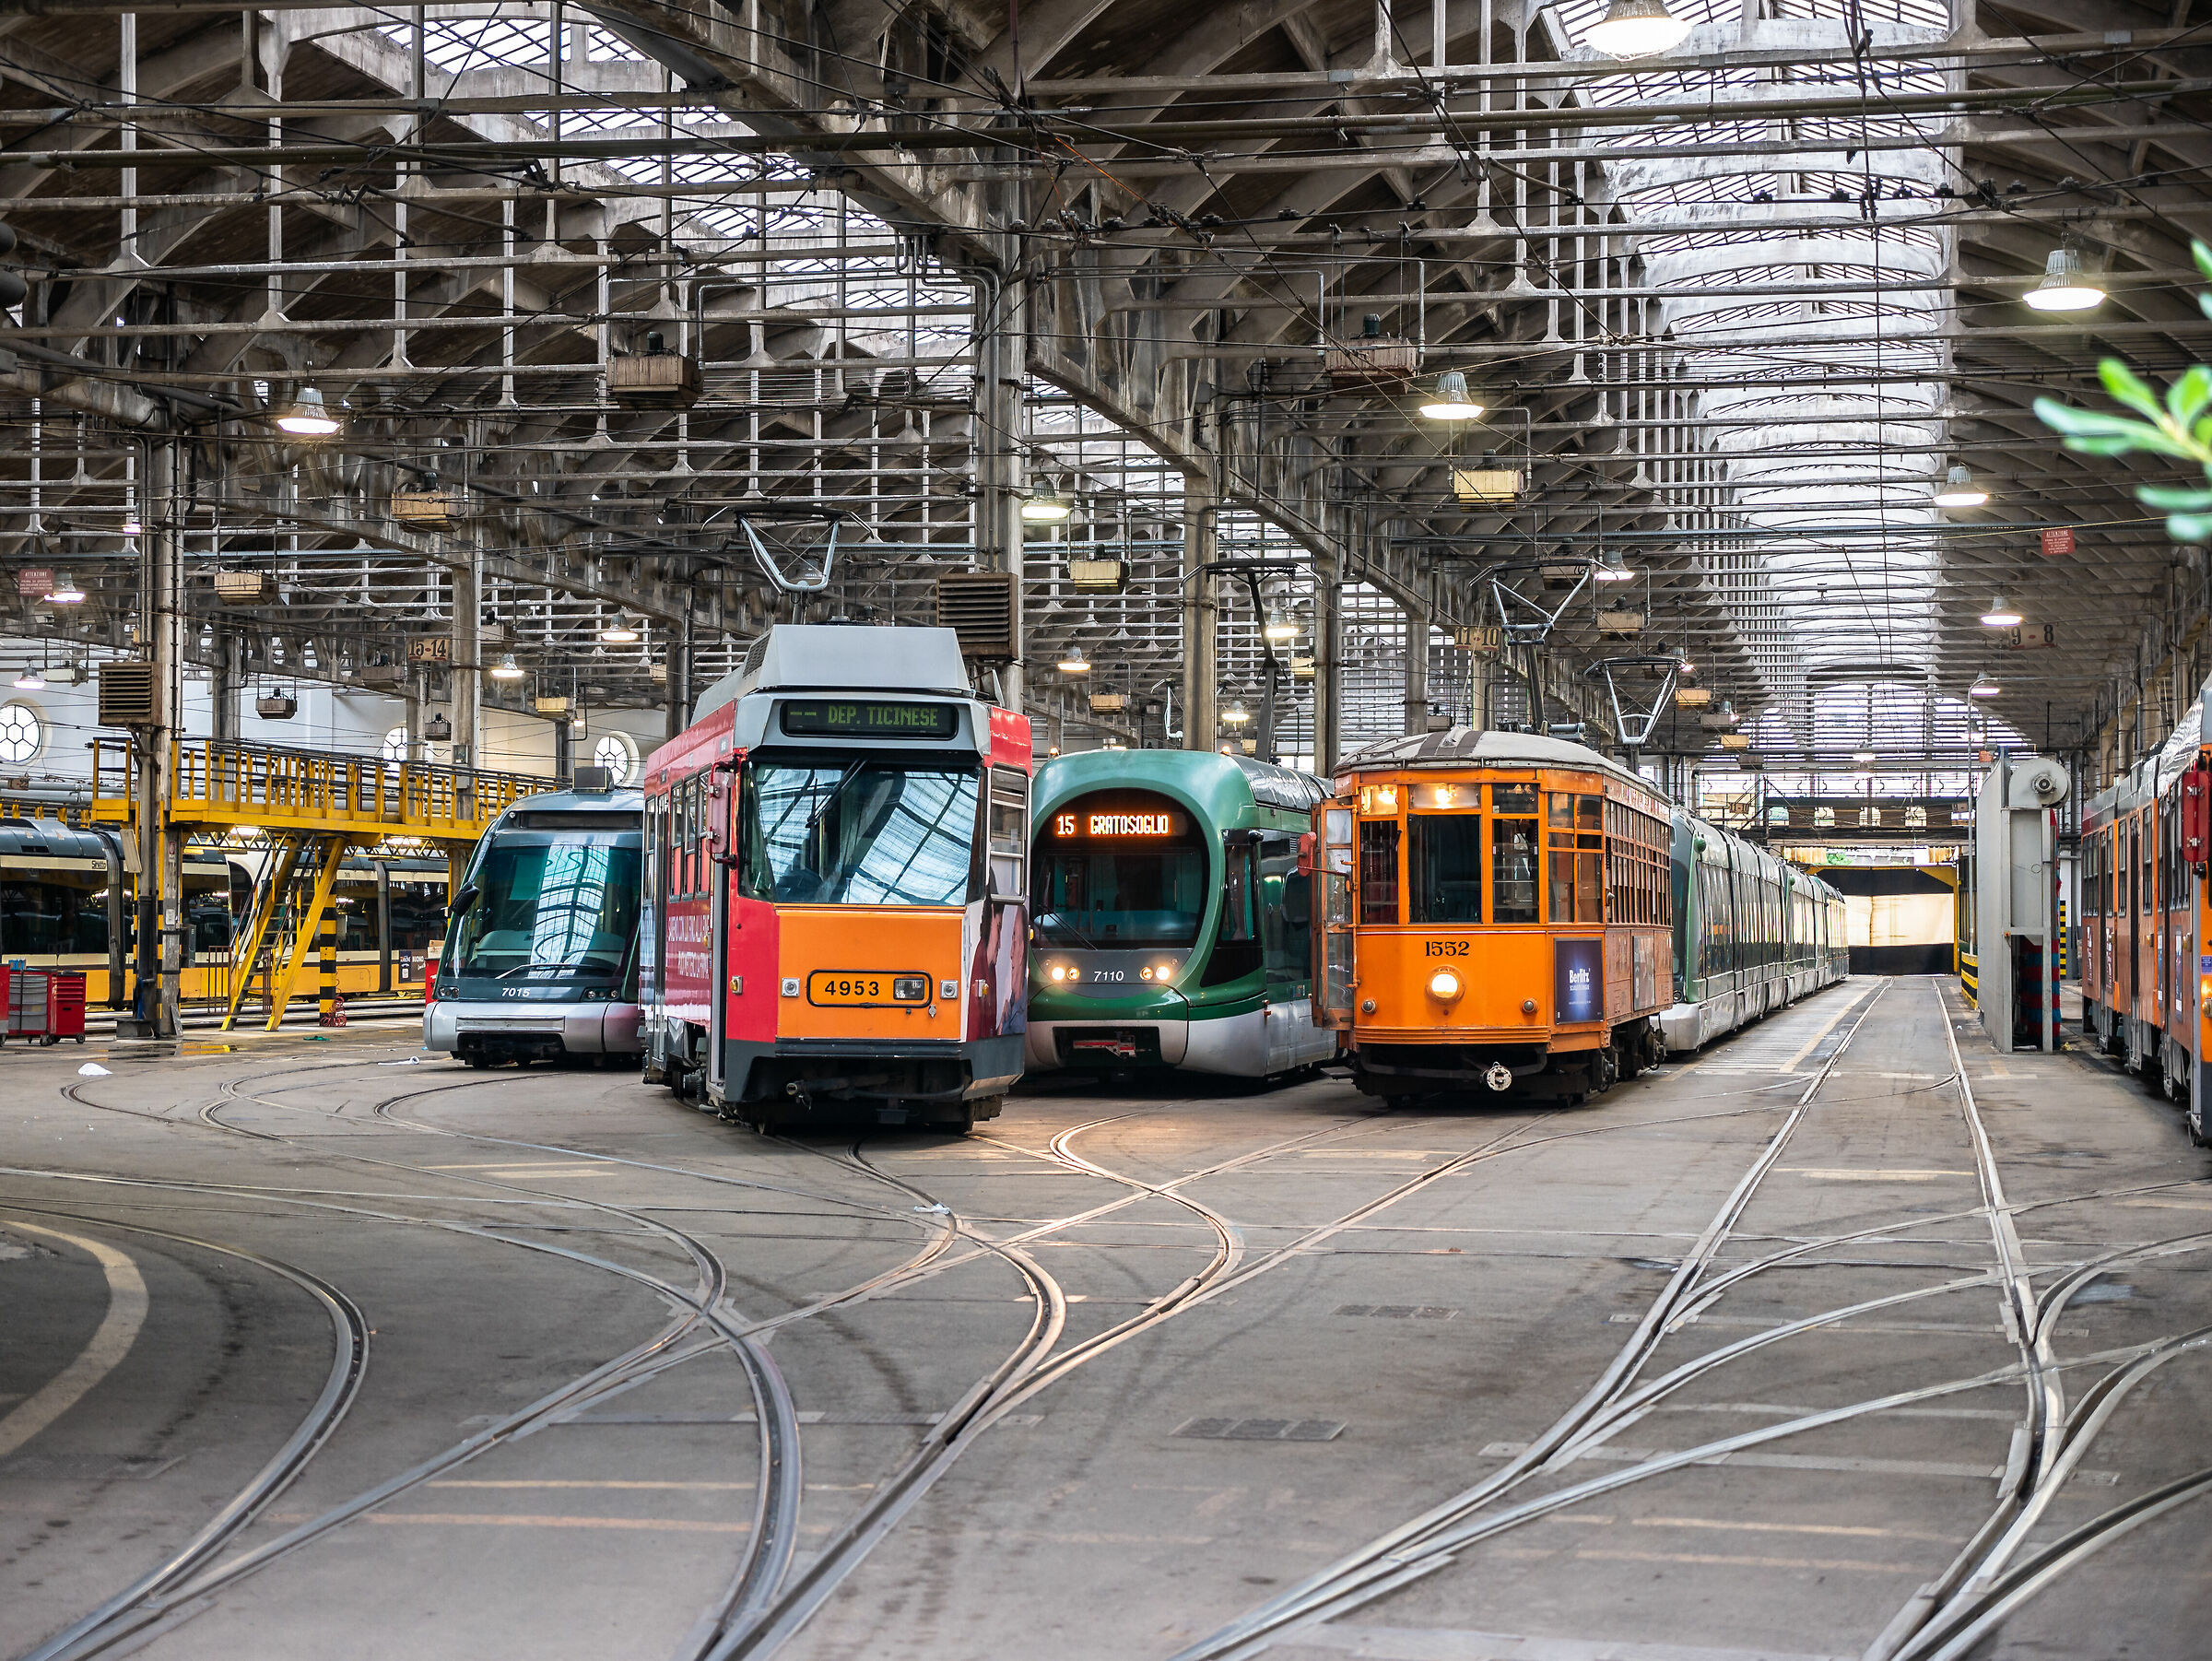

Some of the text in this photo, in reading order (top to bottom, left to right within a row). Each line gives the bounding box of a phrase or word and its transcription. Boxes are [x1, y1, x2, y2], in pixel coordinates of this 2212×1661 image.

[828, 704, 938, 726] DEP. TICINESE
[1057, 815, 1169, 835] 15 GRATOSOGLIO
[1425, 941, 1470, 957] 1552
[1094, 971, 1124, 983] 7110
[501, 987, 531, 997] 7015
[825, 980, 879, 996] 4953
